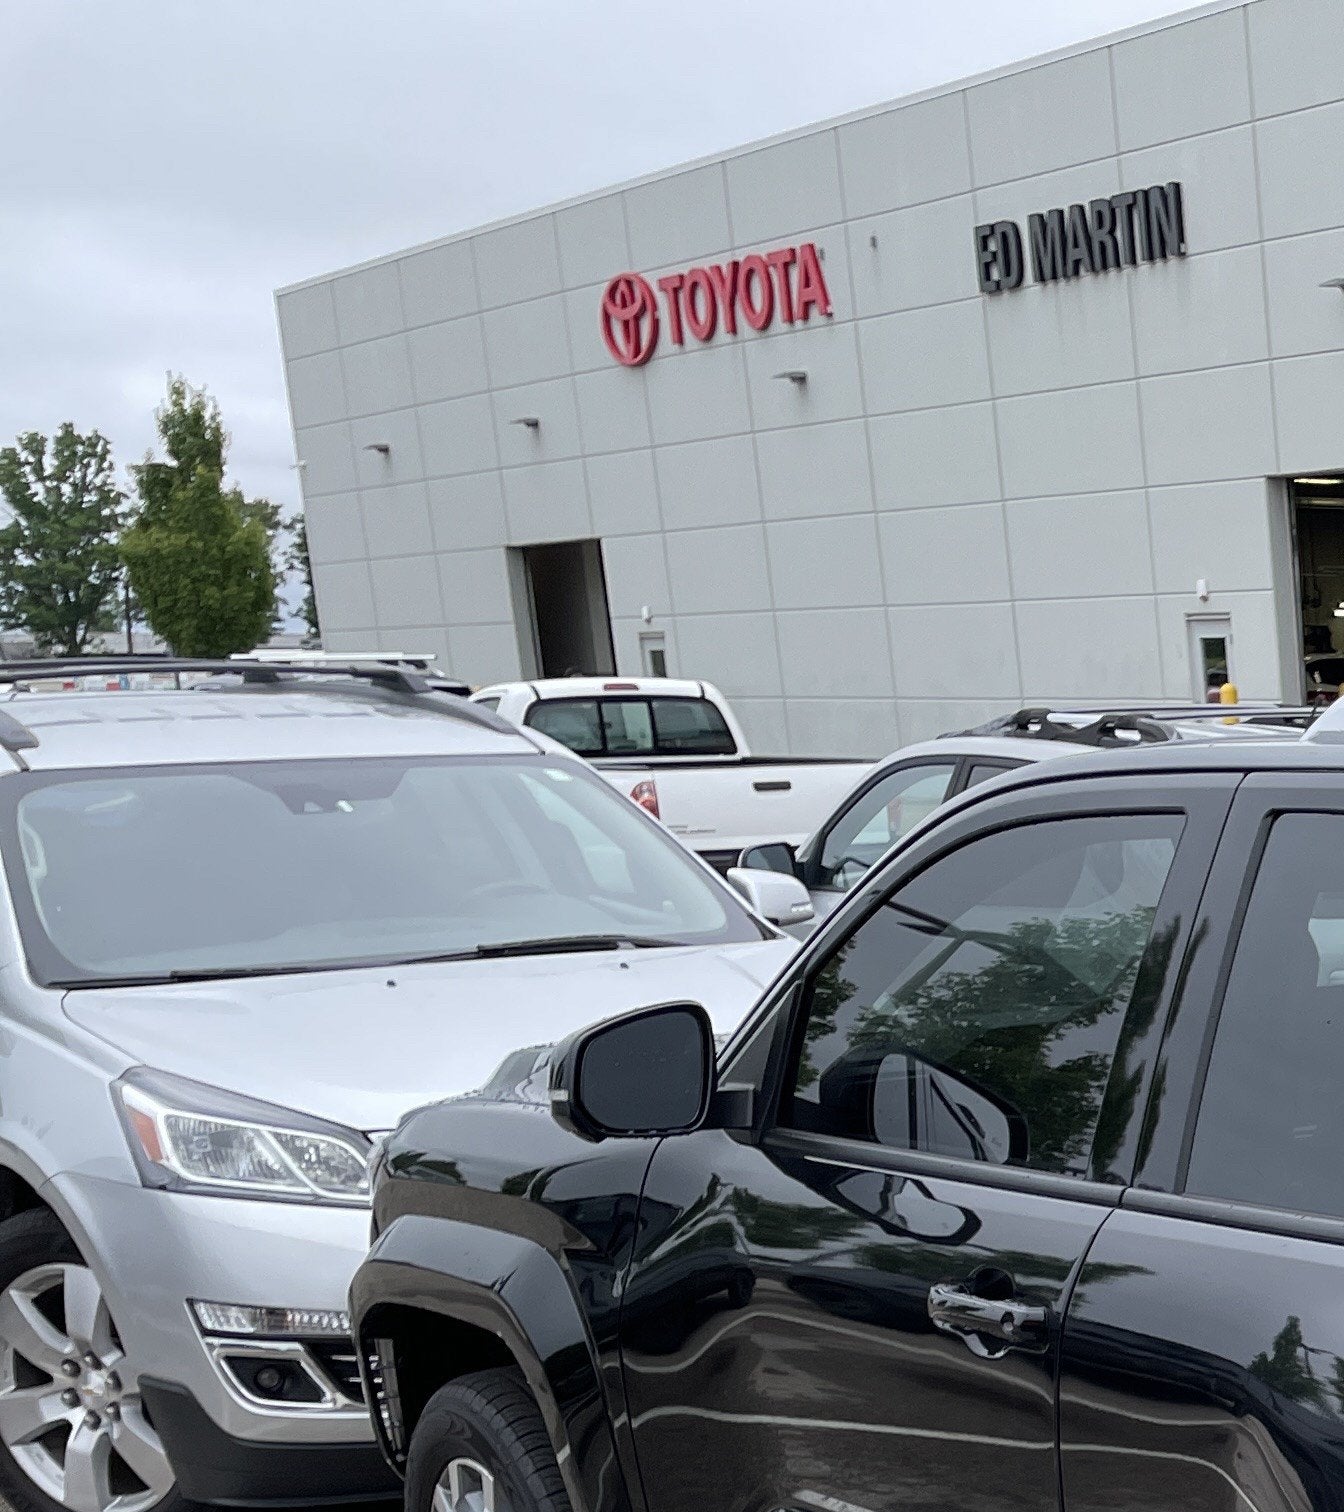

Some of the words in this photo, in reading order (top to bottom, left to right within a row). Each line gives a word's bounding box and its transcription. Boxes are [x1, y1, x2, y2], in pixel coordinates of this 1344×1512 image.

[974, 219, 1024, 294] ED
[1027, 181, 1186, 283] MARTIN
[658, 242, 831, 347] TOYOTA
